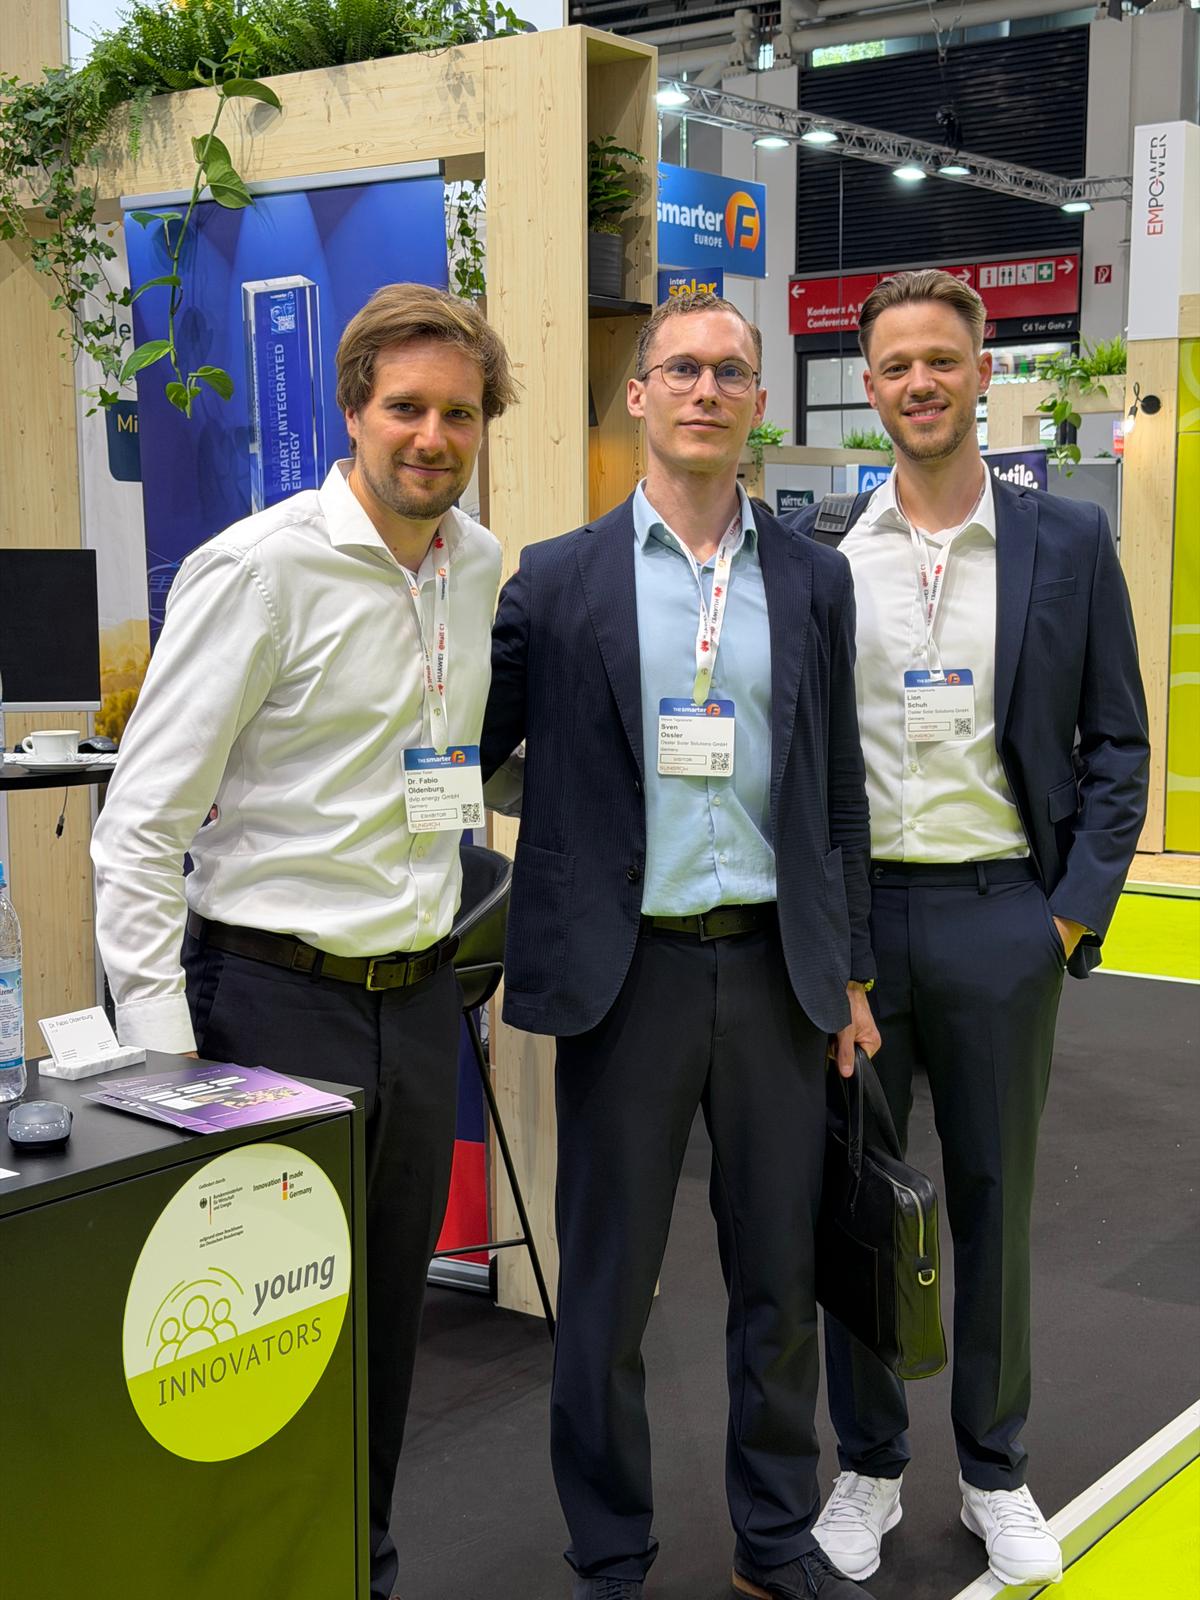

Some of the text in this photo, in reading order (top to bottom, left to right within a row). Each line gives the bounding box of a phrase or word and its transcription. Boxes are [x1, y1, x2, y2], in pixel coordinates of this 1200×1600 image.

[1147, 134, 1167, 235] EMPOWER
[694, 233, 722, 248] EUROPE
[807, 305, 846, 317] Konferenz
[807, 317, 849, 329] Conference
[1022, 323, 1033, 332] C4
[1034, 322, 1047, 331] Tor
[1048, 321, 1066, 330] Gate
[275, 344, 288, 437] INTEGRATED
[279, 441, 291, 491] SMART
[289, 431, 302, 490] ENERGY
[408, 786, 445, 794] Oldenburg
[253, 1170, 304, 1191] Innovation made
[289, 1187, 312, 1199] Germany
[252, 1254, 336, 1317] young
[158, 1316, 322, 1407] INNOVATORS
